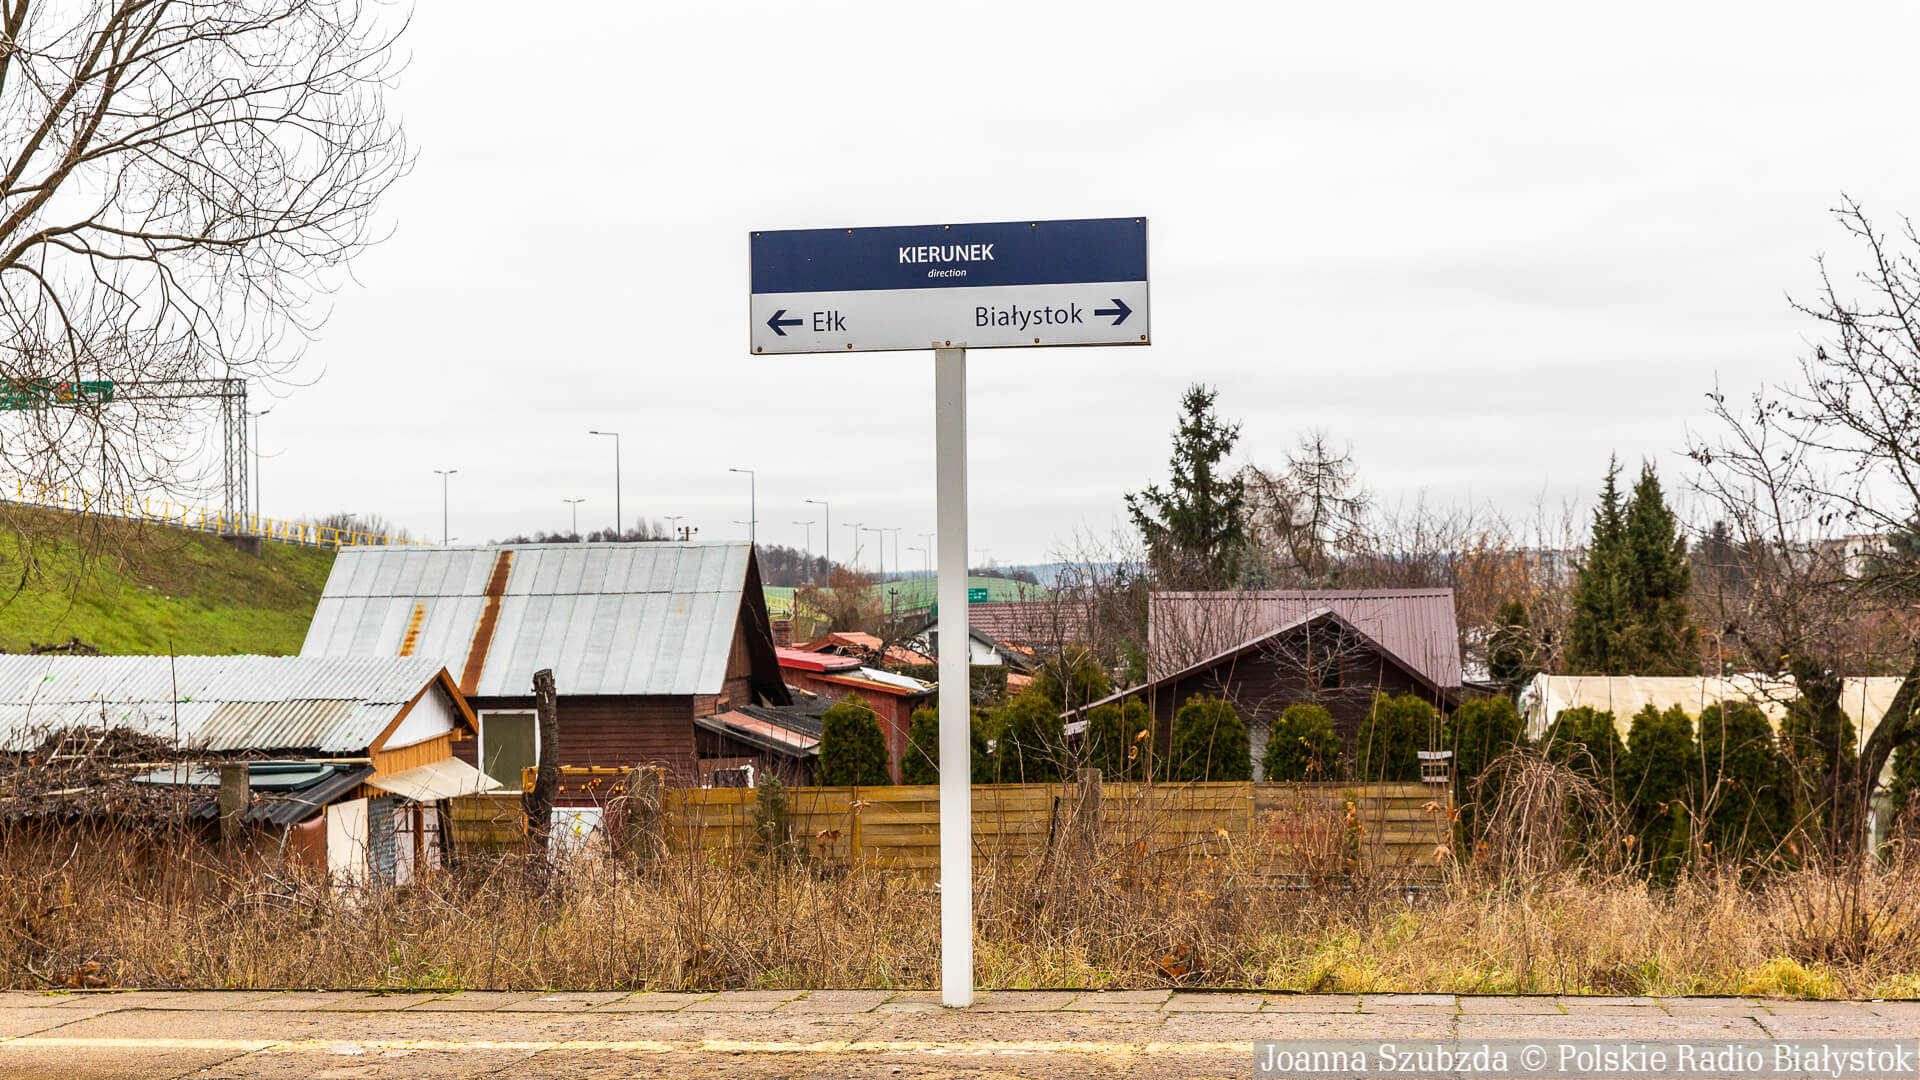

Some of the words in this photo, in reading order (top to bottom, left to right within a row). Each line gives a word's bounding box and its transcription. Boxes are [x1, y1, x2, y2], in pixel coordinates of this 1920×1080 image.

[899, 243, 995, 264] KIERUNEK
[927, 267, 967, 279] direction
[813, 310, 847, 332] Ełk
[975, 302, 1083, 332] Białystok
